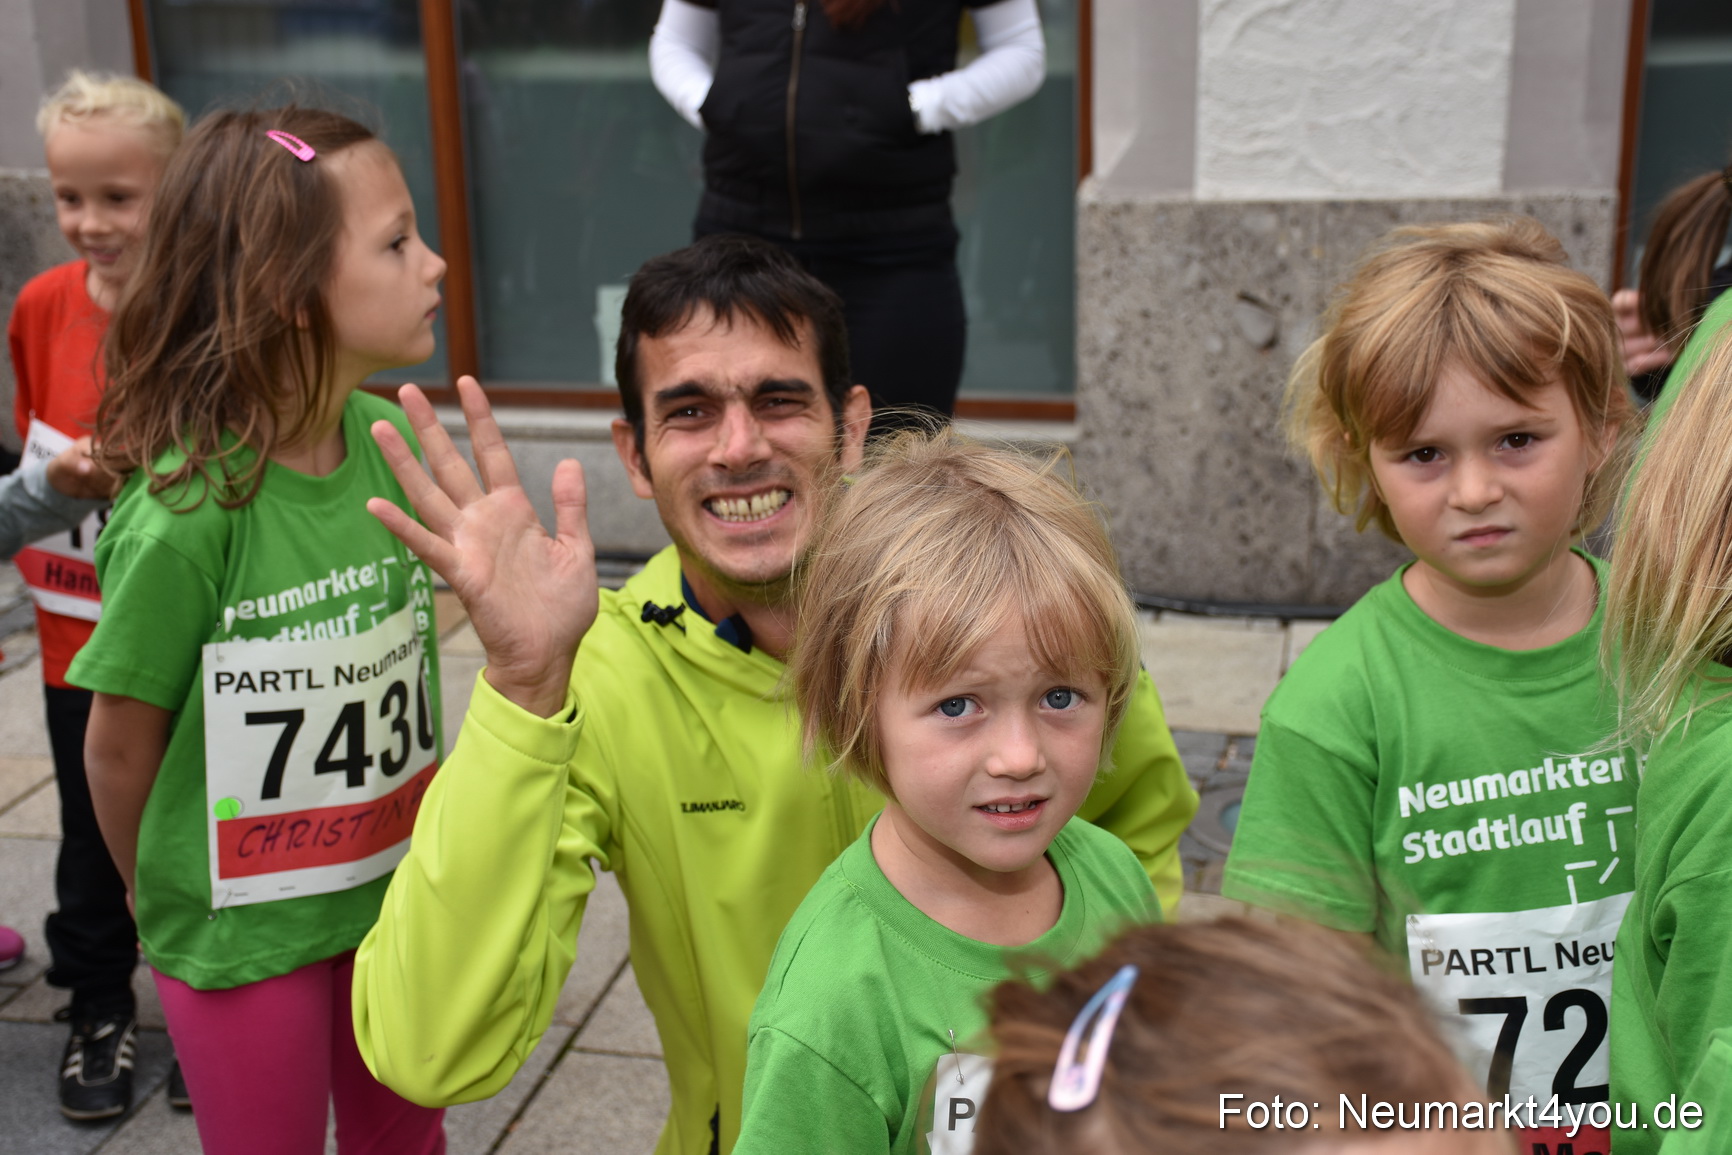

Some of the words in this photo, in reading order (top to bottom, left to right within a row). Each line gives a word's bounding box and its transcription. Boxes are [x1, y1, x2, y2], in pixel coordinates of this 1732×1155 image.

[215, 669, 324, 693] PARTL
[245, 657, 434, 800] 7430
[1398, 756, 1626, 818] Neumarkter
[1402, 802, 1587, 864] Stadtlauf
[1421, 946, 1547, 976] PARTL
[948, 1097, 977, 1132] P
